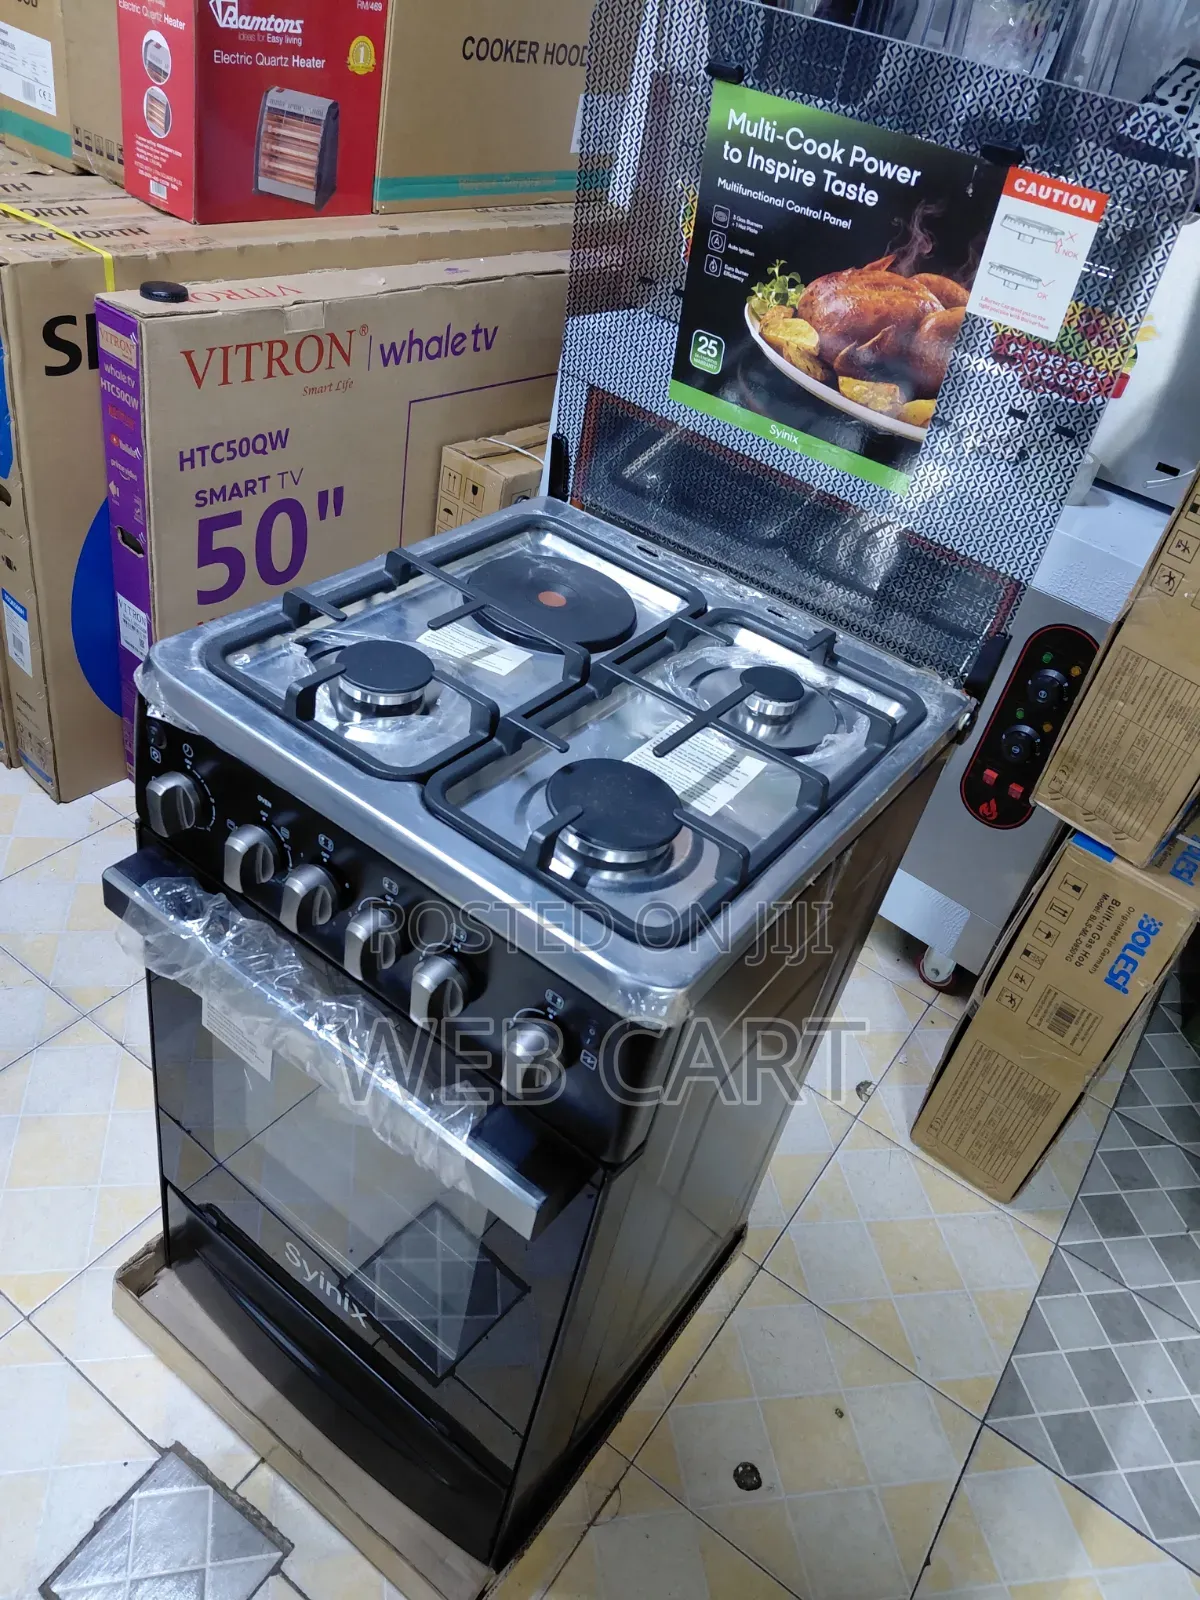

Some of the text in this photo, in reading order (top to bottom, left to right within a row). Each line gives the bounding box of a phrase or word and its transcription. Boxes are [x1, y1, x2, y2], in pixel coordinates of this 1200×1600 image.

[119, 0, 141, 14] Electric
[141, 7, 162, 22] Quartz
[163, 13, 186, 31] Heater
[209, 0, 304, 34] Ramtons
[267, 34, 283, 45] Easy
[284, 35, 302, 46] living
[462, 36, 540, 64] COOKER
[214, 50, 326, 69] Electric Quartz Heater
[727, 108, 922, 187] Multi-Cook Power
[723, 141, 879, 206] to Inspire Taste
[718, 177, 852, 230] Multifunctional Control Panel
[1014, 178, 1097, 213] CAUTION
[6, 227, 151, 243] SKYORTH
[747, 218, 764, 229] Burners
[728, 243, 738, 252] Auto
[1062, 248, 1079, 260] NOK
[723, 270, 745, 283] Efficiency
[735, 267, 749, 278] Burner
[185, 284, 303, 303] VITRO
[1037, 292, 1048, 300] OK
[697, 335, 718, 358] 25
[100, 377, 139, 410] HTC50QW
[302, 379, 354, 397] Smart Life
[769, 425, 799, 445] Syinix
[179, 428, 290, 472] HTC50QW
[195, 468, 304, 508] SMART TV
[196, 486, 344, 605] 50"
[1092, 892, 1110, 915] Model:
[1074, 898, 1122, 969] Built-in Gas Hob
[1109, 905, 1136, 942] Originated
[1088, 946, 1111, 976] Germany
[285, 1241, 367, 1329] Syinix
